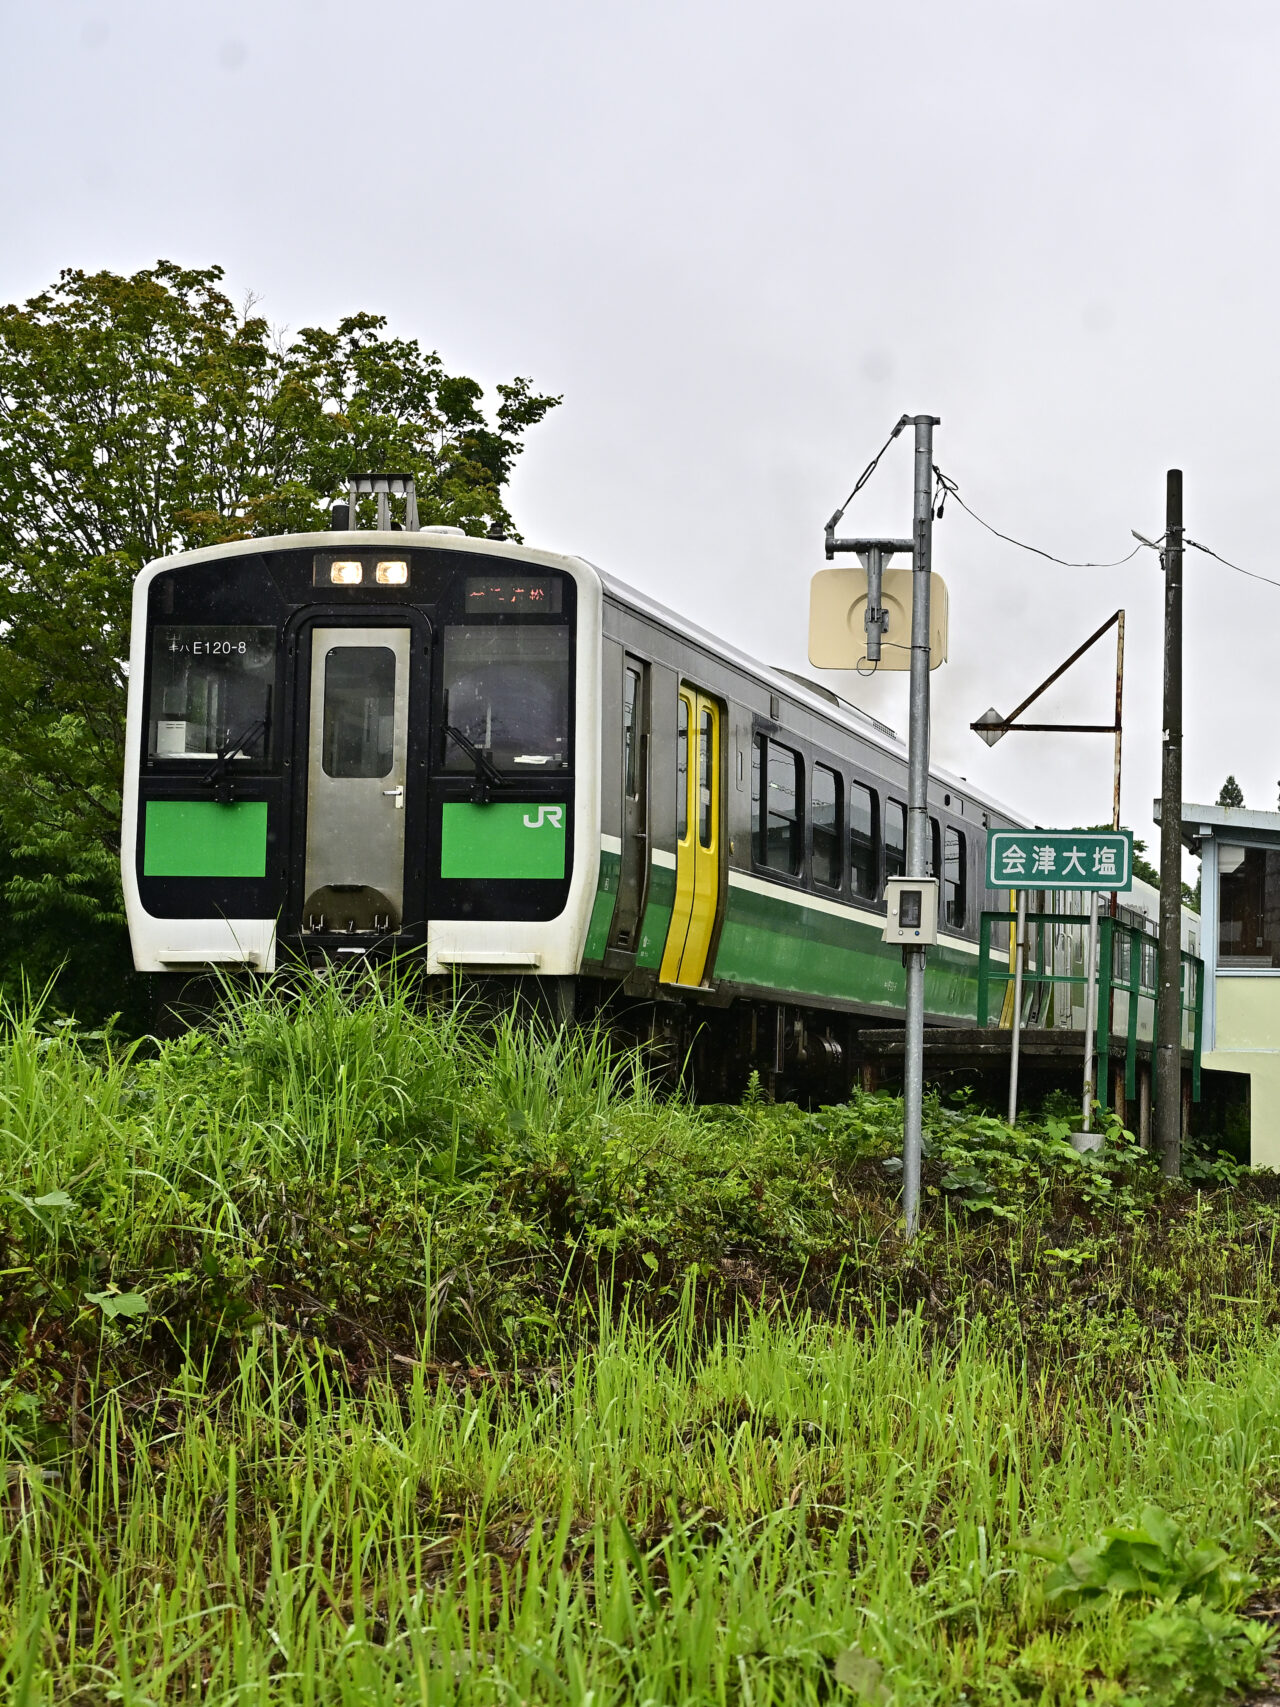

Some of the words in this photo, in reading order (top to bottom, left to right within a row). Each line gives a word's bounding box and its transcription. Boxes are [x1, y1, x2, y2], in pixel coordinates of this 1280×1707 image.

[523, 806, 562, 828] JR
[1002, 844, 1117, 876] 会津大塩
